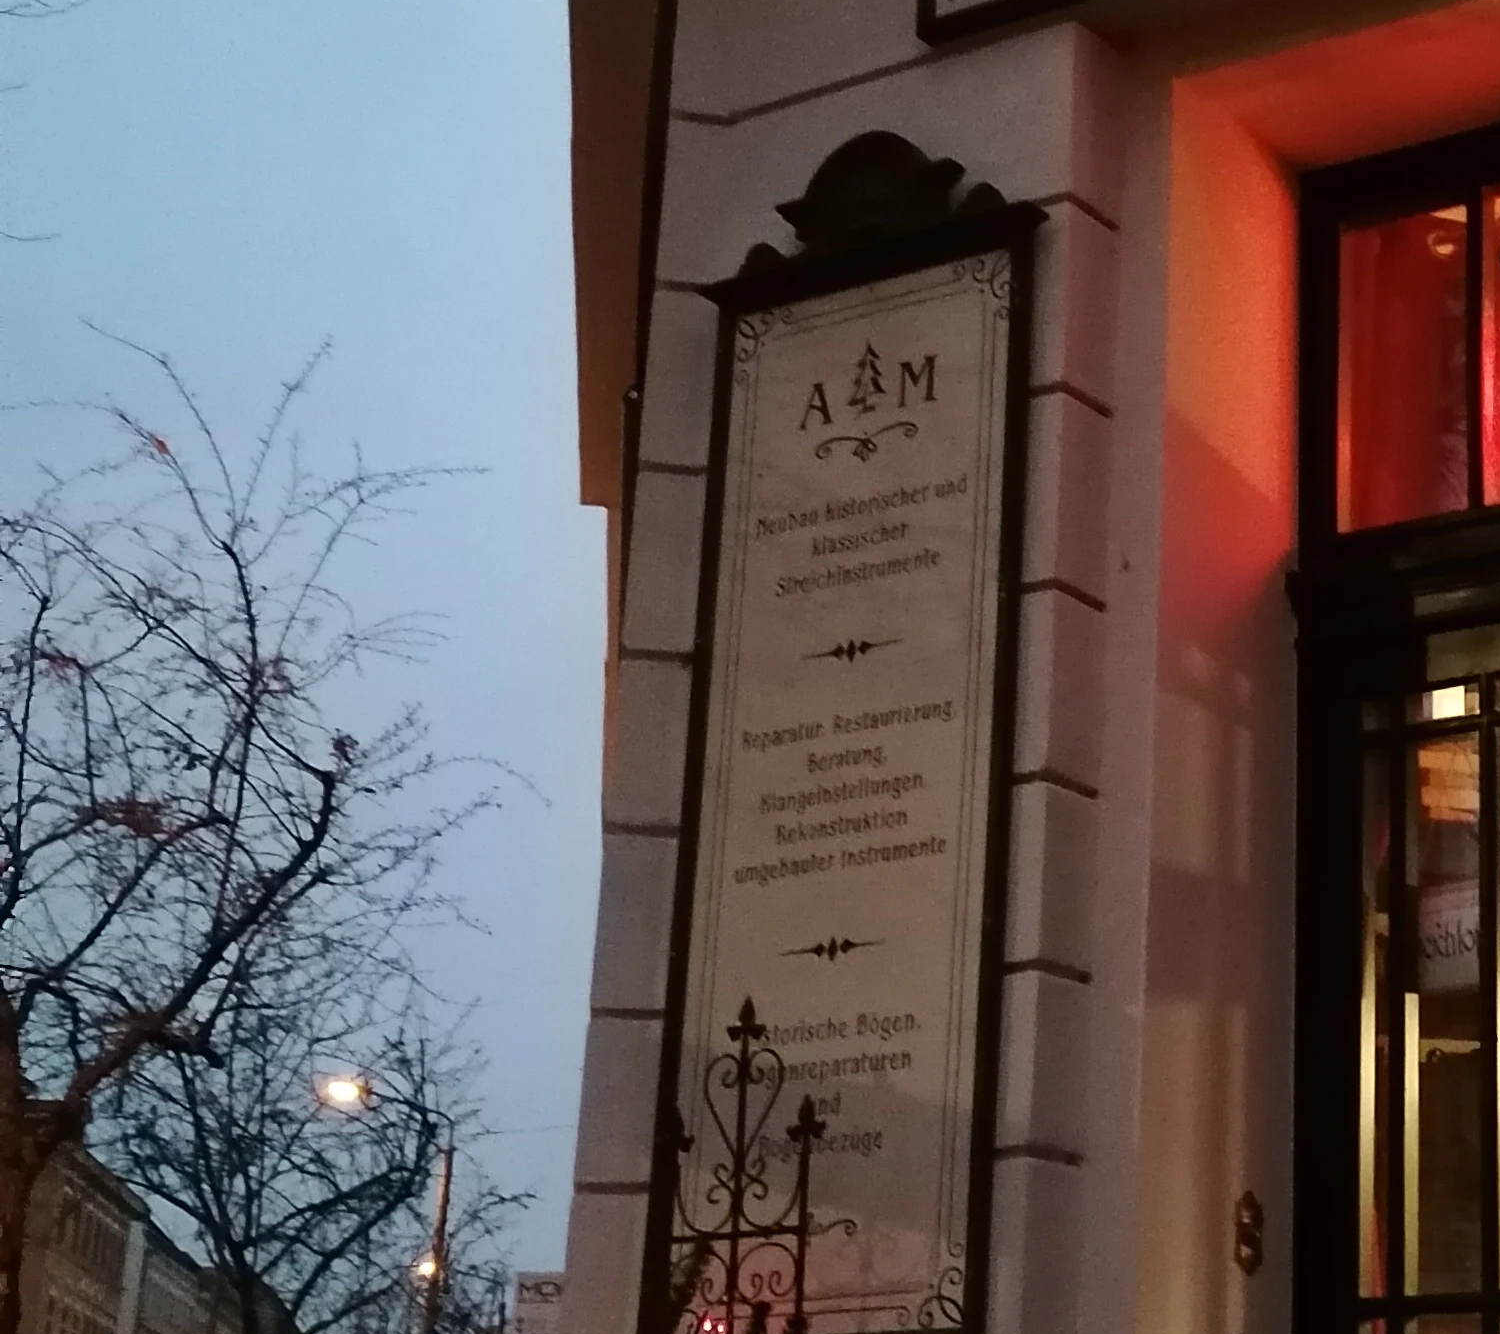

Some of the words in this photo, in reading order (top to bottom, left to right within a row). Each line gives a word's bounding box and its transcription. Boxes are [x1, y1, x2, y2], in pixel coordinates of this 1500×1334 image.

[800, 382, 832, 431] A
[899, 354, 937, 408] M
[825, 484, 930, 522] historischer
[934, 473, 968, 499] und
[811, 522, 909, 556] klassischer
[775, 548, 941, 598] Streichinstrumente
[841, 836, 948, 869] Instrumente
